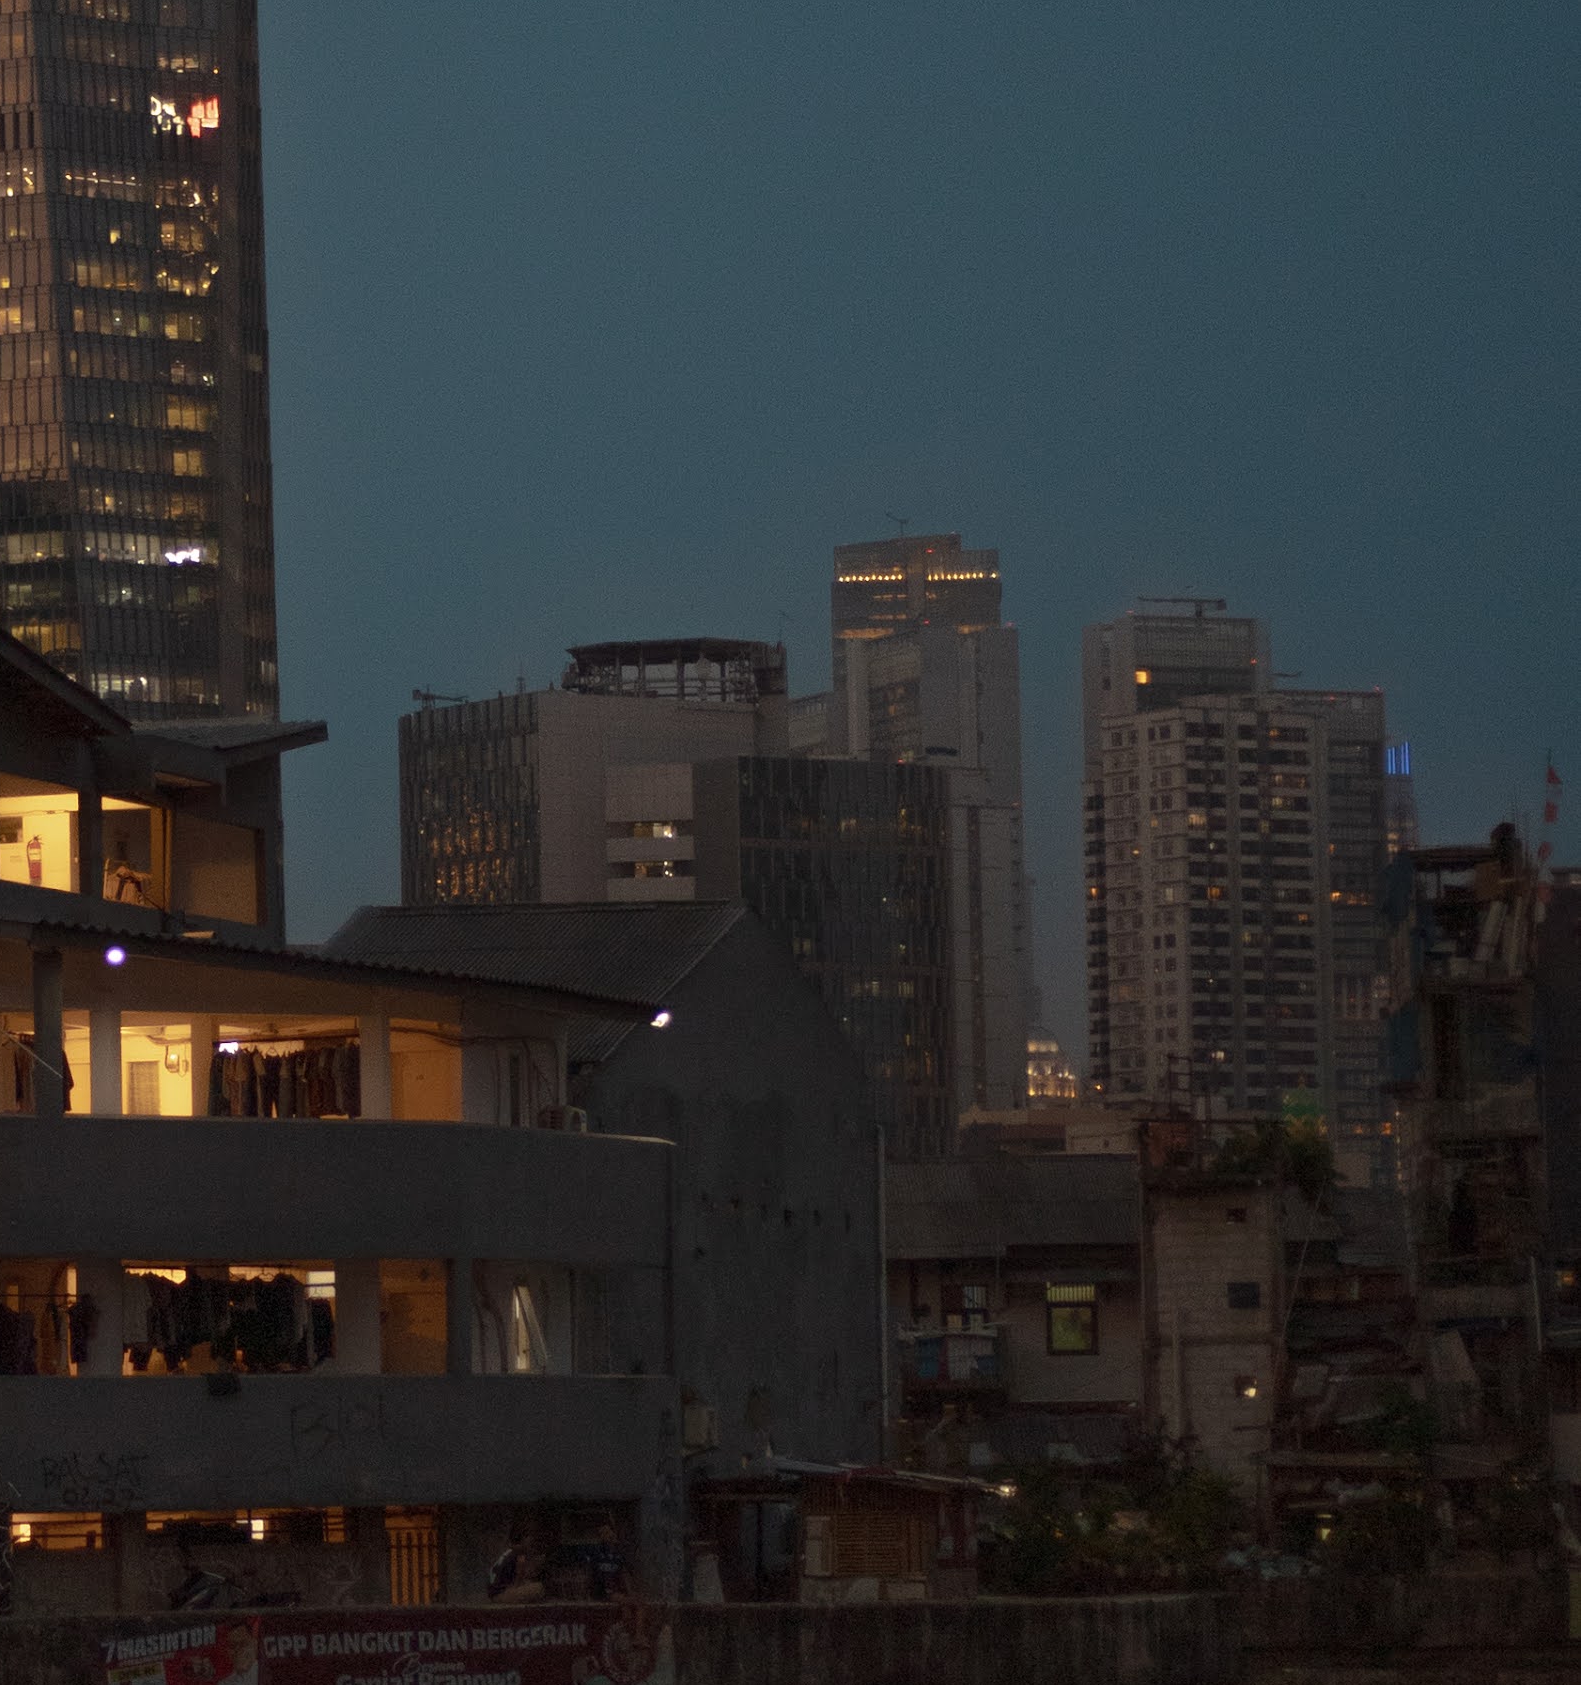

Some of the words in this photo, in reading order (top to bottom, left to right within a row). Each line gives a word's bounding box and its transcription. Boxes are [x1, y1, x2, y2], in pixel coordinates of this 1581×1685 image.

[263, 1634, 308, 1659] GPP
[311, 1630, 414, 1656] BANGKIT
[418, 1627, 468, 1652] DAN
[472, 1623, 589, 1650] BERGERAK
